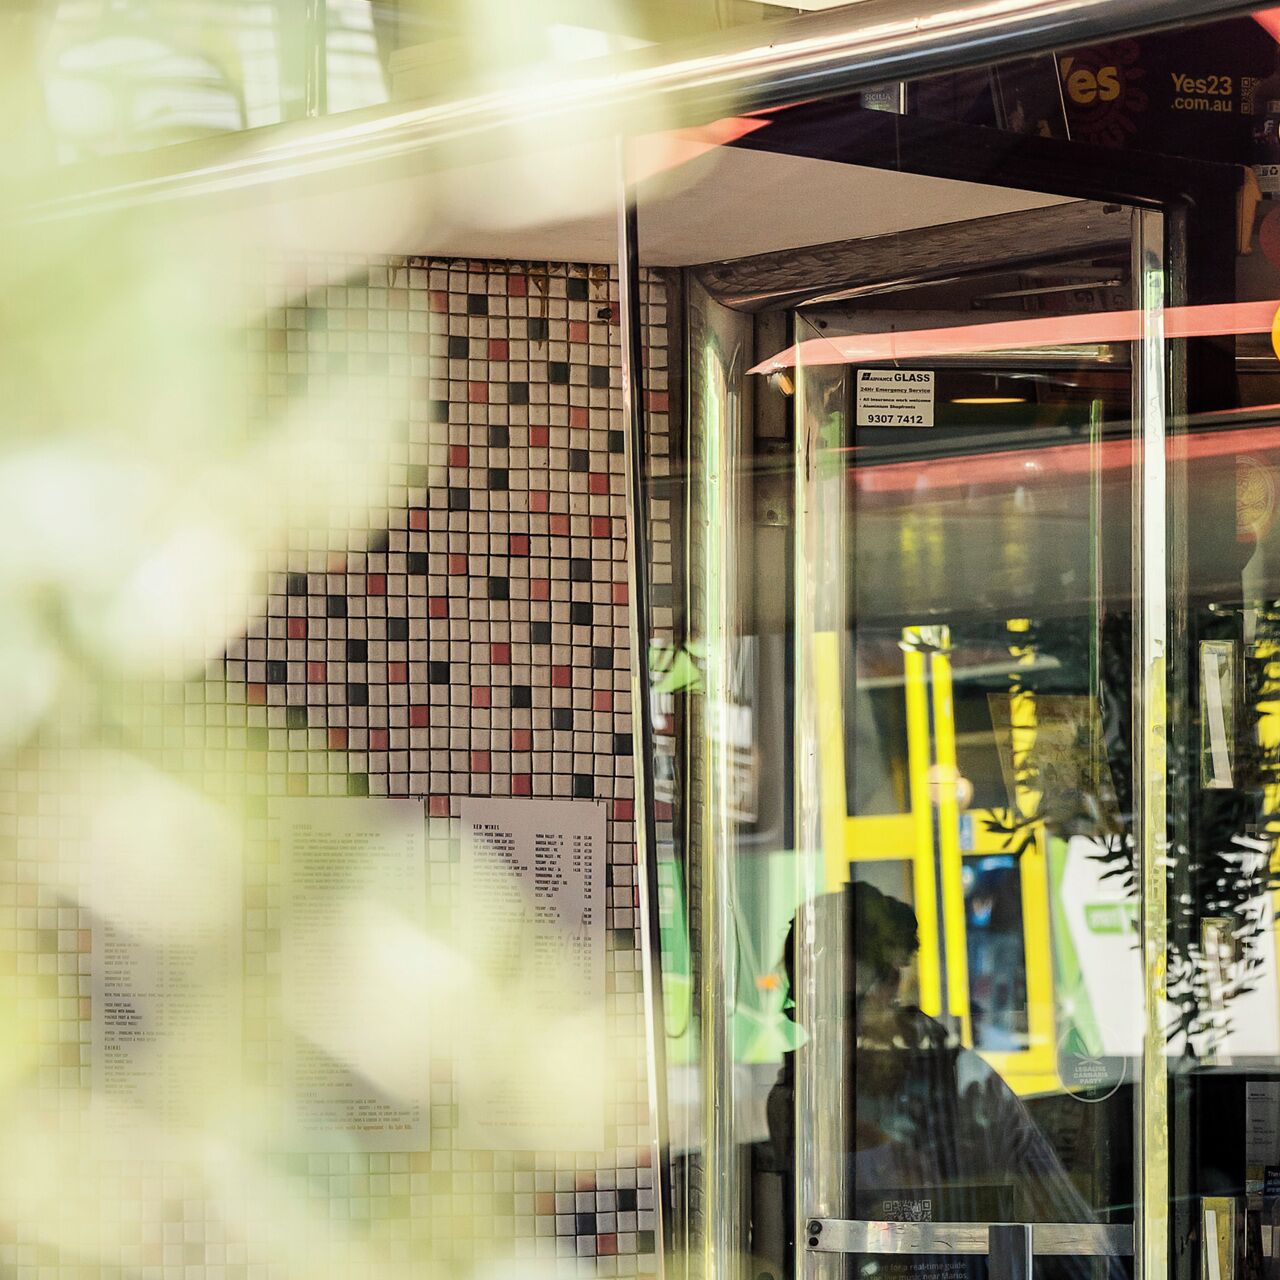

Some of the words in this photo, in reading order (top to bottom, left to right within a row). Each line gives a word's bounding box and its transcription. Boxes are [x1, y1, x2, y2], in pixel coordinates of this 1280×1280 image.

[1170, 72, 1233, 97] Yes23
[1170, 97, 1233, 113] .com.au
[894, 373, 930, 382] GLASS
[868, 414, 894, 423] 9307
[897, 415, 923, 424] 7412
